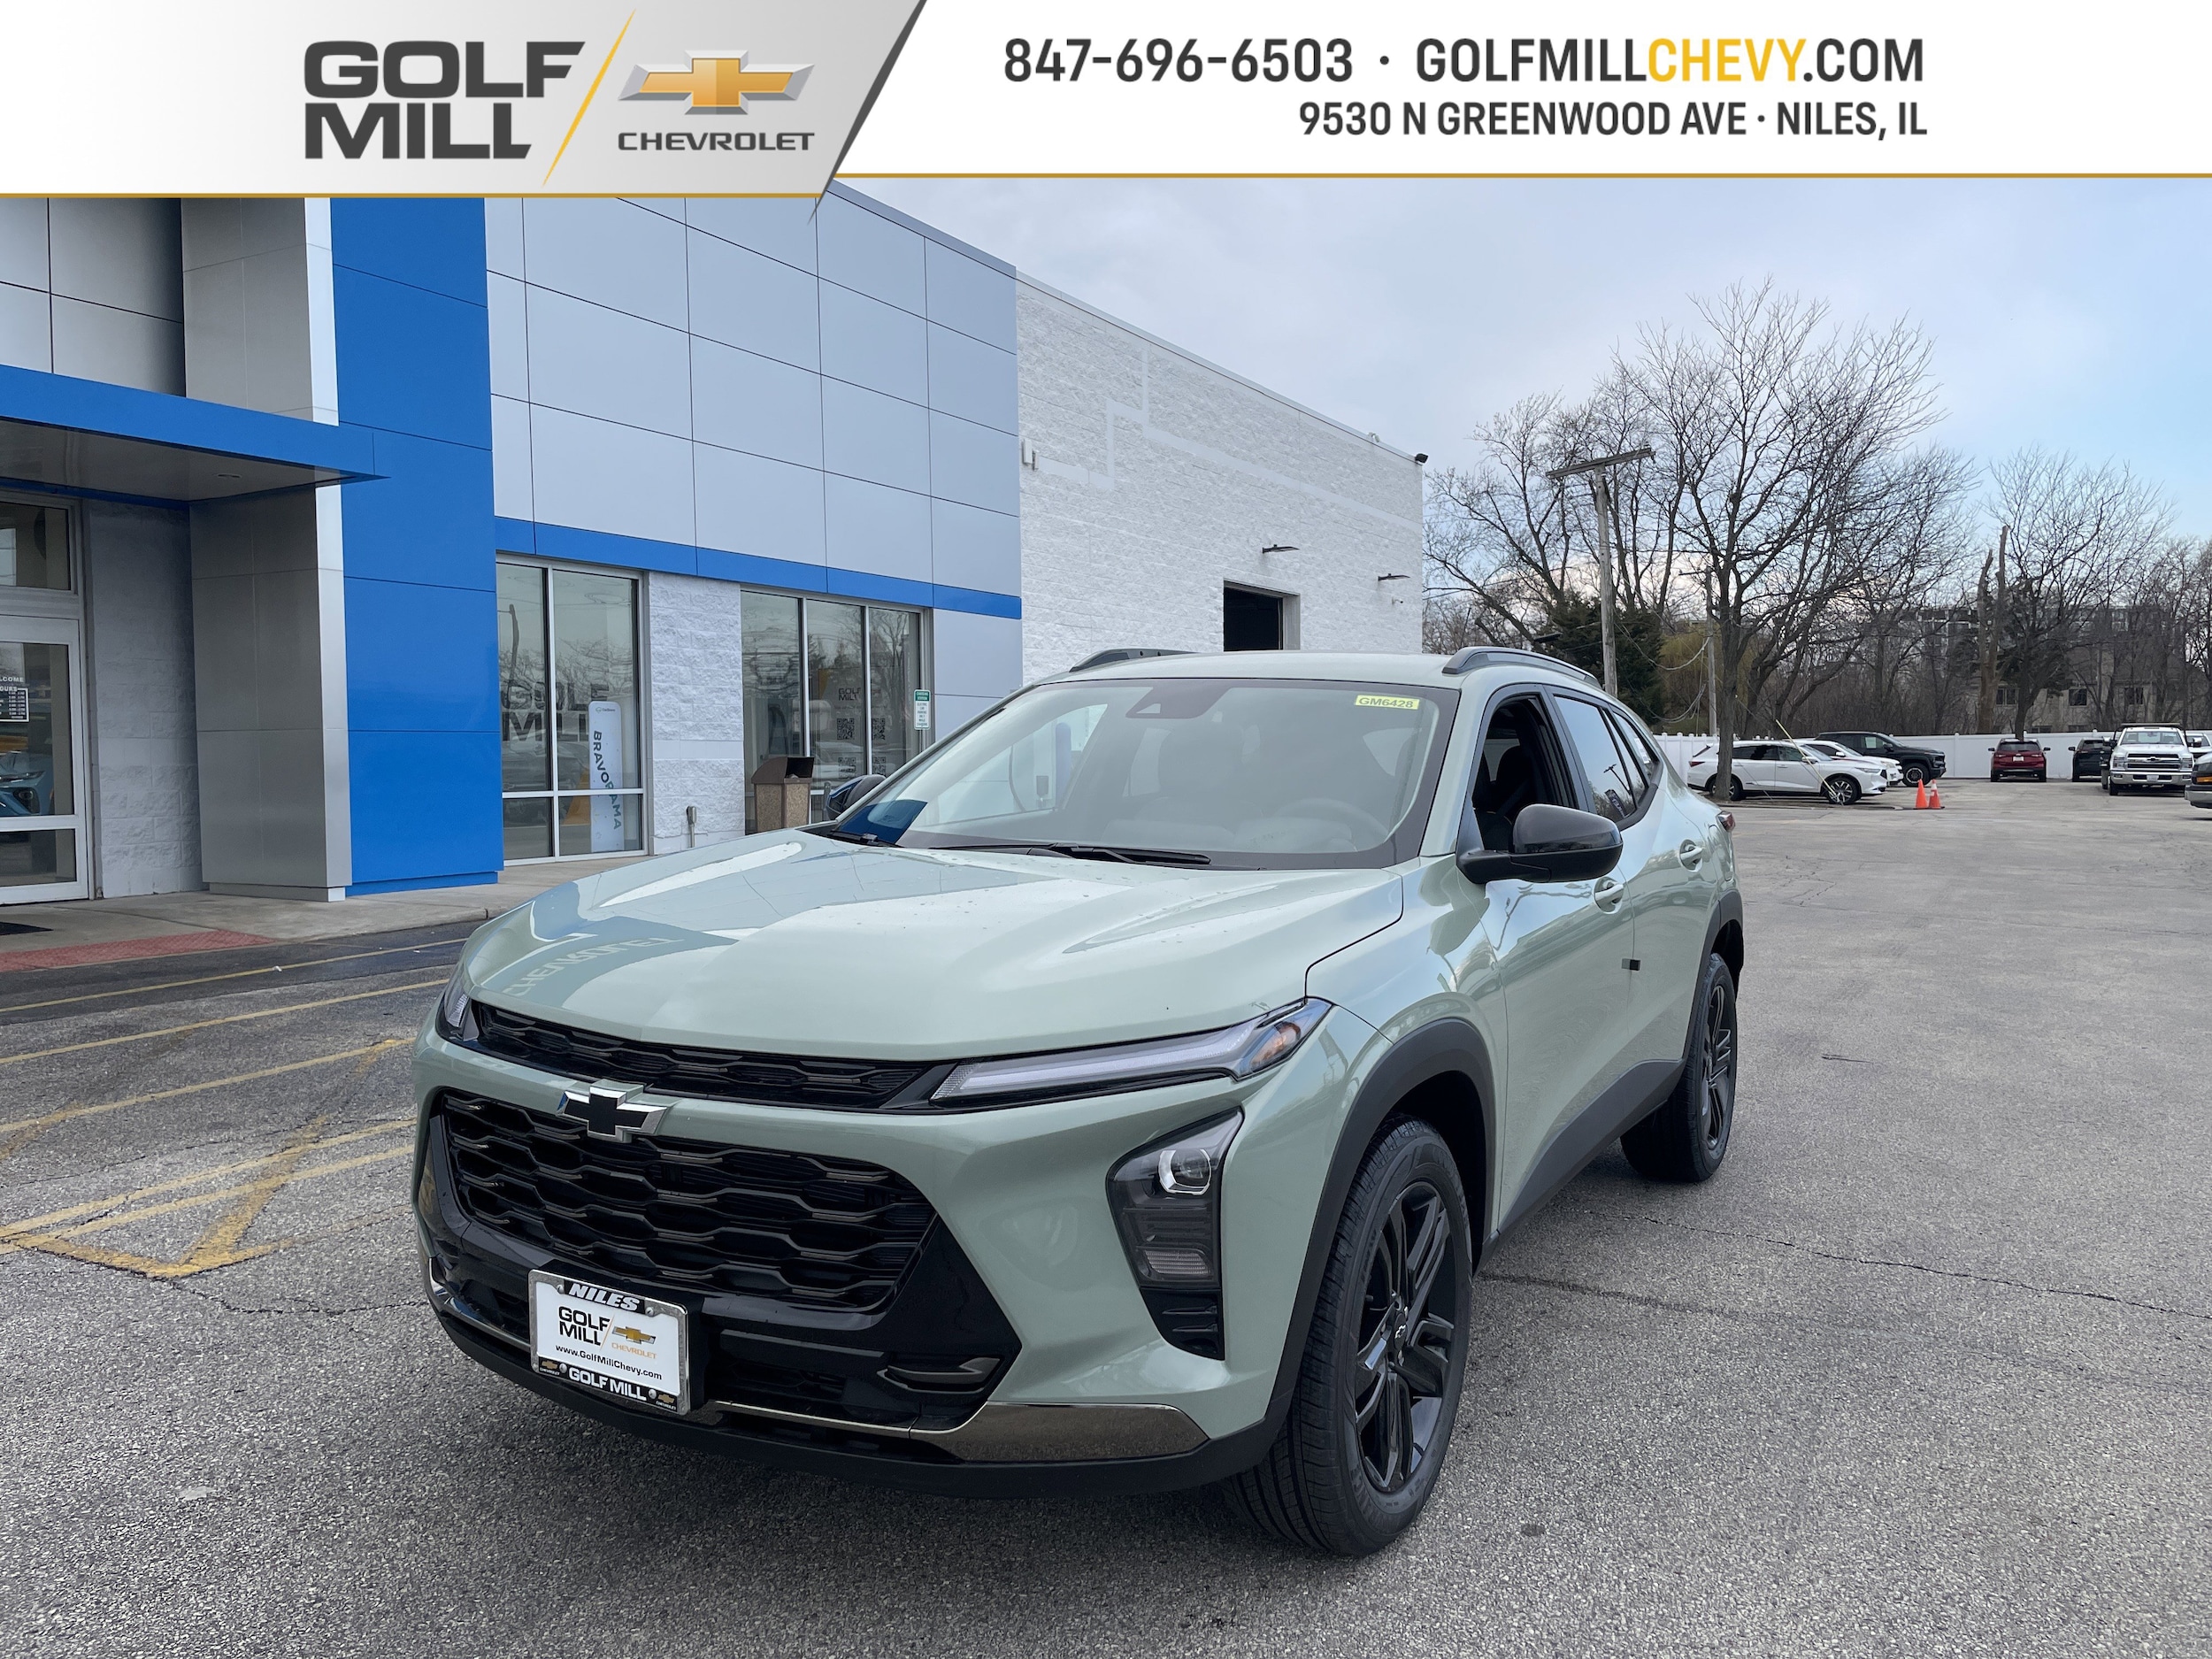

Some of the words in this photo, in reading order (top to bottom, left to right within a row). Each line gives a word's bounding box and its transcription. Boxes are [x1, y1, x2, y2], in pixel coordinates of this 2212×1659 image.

[1358, 697, 1414, 708] GM6428
[502, 711, 590, 742] MLL
[592, 730, 622, 830] BRAVORAMA
[568, 1283, 641, 1311] NILES
[558, 1306, 611, 1332] GOLF
[559, 1320, 602, 1347] MILL
[555, 1344, 663, 1381] www.GolfMillChevy.com
[611, 1341, 657, 1360] CHEVROLET
[568, 1366, 609, 1389] GOLF
[609, 1379, 648, 1402] MILL
